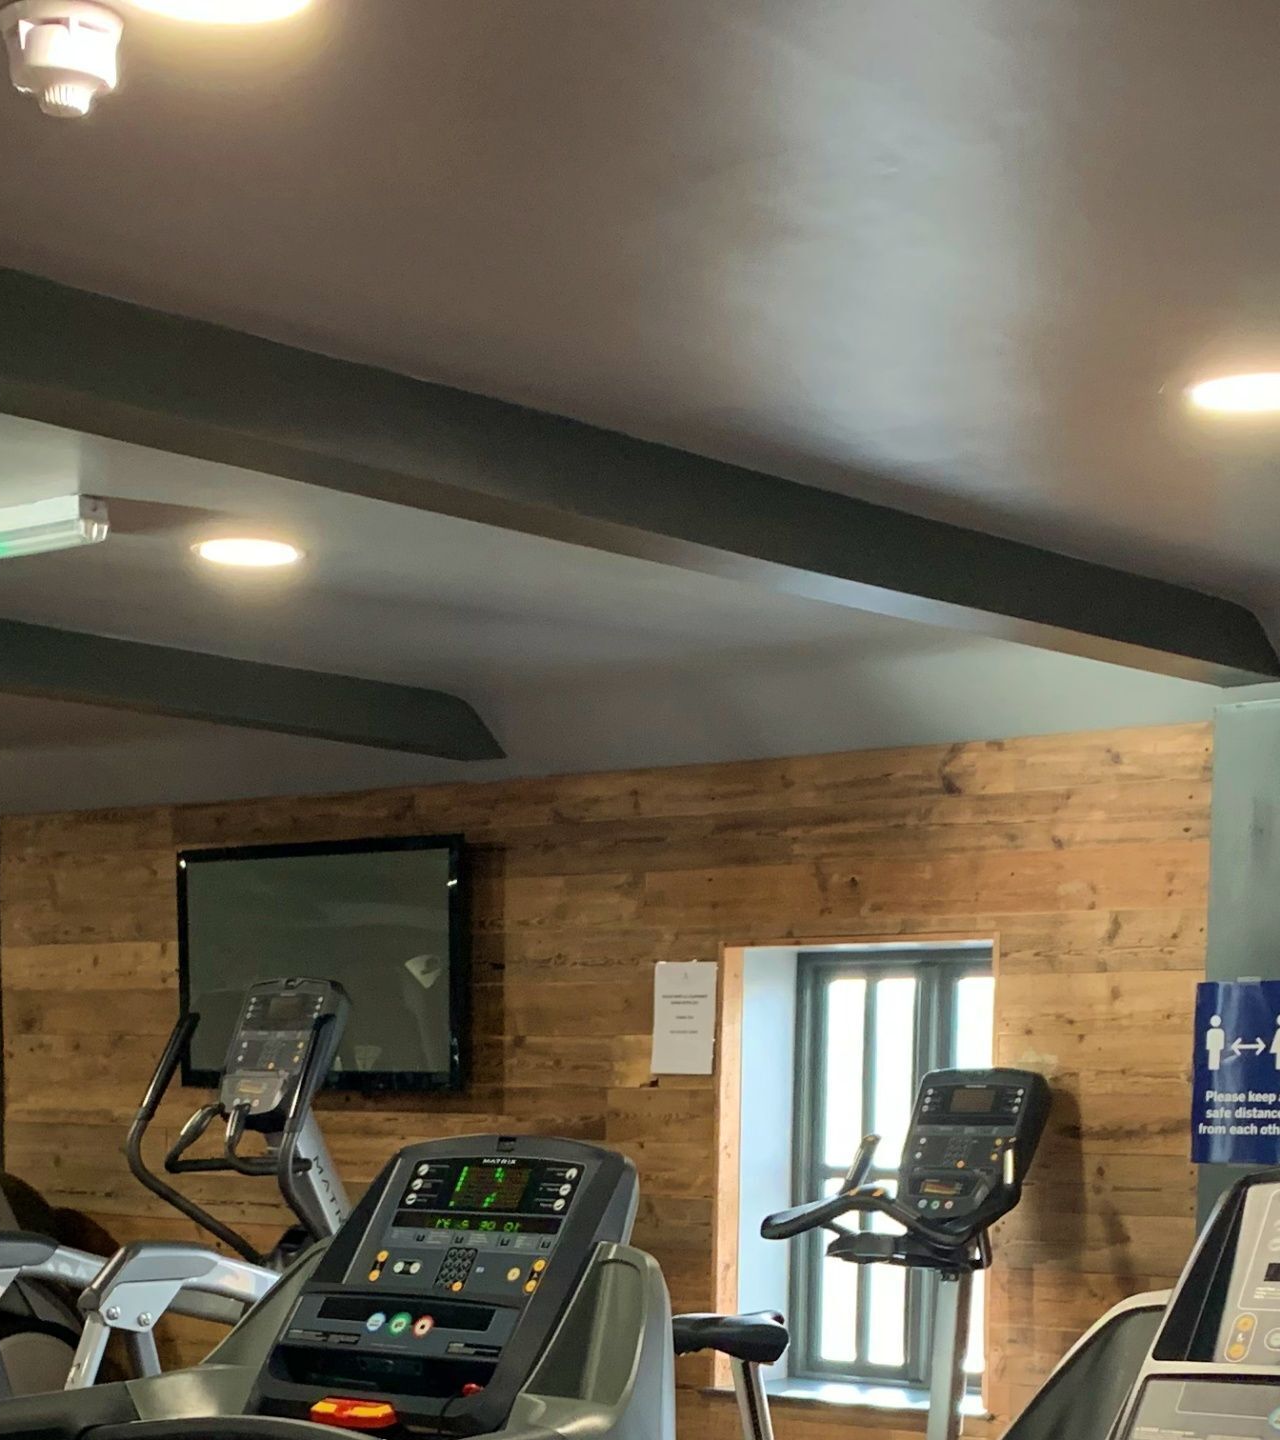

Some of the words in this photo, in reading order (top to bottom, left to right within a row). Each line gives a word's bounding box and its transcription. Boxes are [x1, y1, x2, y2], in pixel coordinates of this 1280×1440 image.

[1205, 1090, 1246, 1103] Please
[1248, 1090, 1276, 1105] keep
[1205, 1107, 1232, 1119] safe
[1198, 1123, 1227, 1135] from
[1229, 1123, 1258, 1135] each
